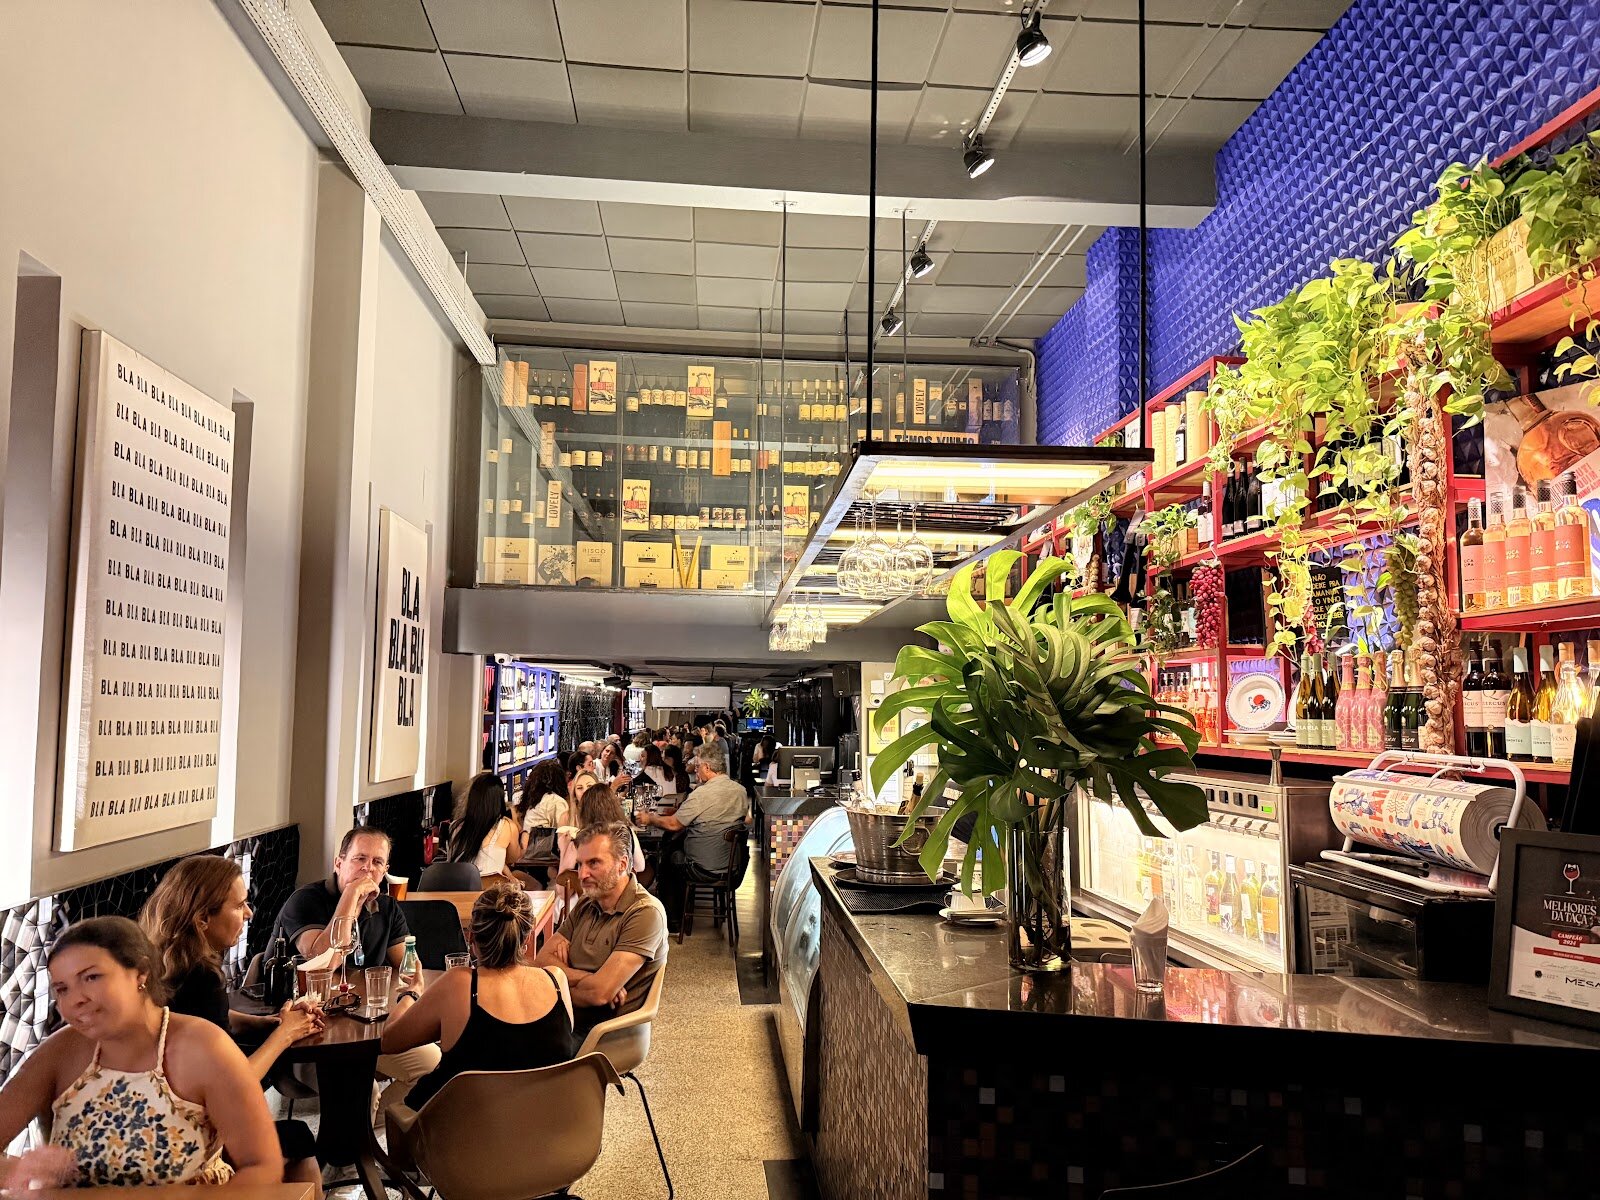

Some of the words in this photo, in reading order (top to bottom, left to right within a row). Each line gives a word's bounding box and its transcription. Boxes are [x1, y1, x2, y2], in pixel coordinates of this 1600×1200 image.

[118, 363, 133, 386] BLA
[137, 376, 147, 394] BLA
[152, 385, 165, 405] BLA
[169, 395, 178, 413] BLA
[182, 403, 191, 420] BLA
[194, 410, 205, 428] BLA
[208, 418, 217, 434] BLA
[220, 425, 230, 443] BLA
[916, 389, 925, 415] LOVELY
[117, 402, 128, 422] BLA
[133, 411, 147, 432] BLA
[151, 421, 160, 439] BLA
[165, 429, 177, 448] BLA
[181, 438, 193, 456] BLA
[196, 446, 204, 461] BLA
[208, 451, 218, 468] BLA
[114, 441, 131, 462] BLA
[135, 451, 145, 470] BLA
[149, 458, 162, 477] BLA
[166, 466, 176, 483] BLA
[179, 472, 189, 488] BLA
[192, 478, 203, 495] BLA
[206, 484, 214, 499] BLA
[217, 489, 227, 506] BLA
[112, 481, 125, 499] BLA
[129, 487, 143, 507] BLA
[148, 495, 158, 512] BLA
[161, 501, 174, 518] BLA
[178, 507, 190, 524] BLA
[193, 513, 202, 528] BLA
[205, 518, 215, 533] BLA
[218, 523, 226, 538] BLA
[549, 491, 559, 519] LOVELY
[110, 520, 127, 539] BLA
[131, 527, 142, 544] BLA
[146, 532, 159, 550] BLA
[163, 538, 173, 553] BLA
[176, 542, 185, 558] BLA
[189, 546, 200, 562] BLA
[203, 551, 211, 565] BLA
[214, 555, 224, 570] BLA
[108, 559, 121, 577] BLA
[125, 564, 140, 582] BLA
[144, 570, 154, 586] BLA
[158, 573, 171, 589] BLA
[175, 577, 187, 593] BLA
[190, 581, 199, 596] BLA
[202, 585, 213, 599] BLA
[401, 567, 419, 622] BLA
[1312, 574, 1326, 582] NÃO
[106, 599, 122, 617] BLA
[127, 604, 138, 620] BLA
[142, 607, 156, 623] BLA
[160, 611, 169, 625] BLA
[173, 613, 182, 628] BLA
[185, 615, 197, 630] BLA
[201, 618, 209, 632] BLA
[212, 620, 221, 634] BLA
[103, 639, 116, 656] BLA
[121, 642, 136, 658] BLA
[140, 645, 150, 660] BLA
[154, 647, 167, 662] BLA
[171, 649, 183, 663] BLA
[187, 650, 195, 664] BLA
[199, 652, 209, 666] BLA
[388, 618, 407, 673] BLA
[410, 626, 424, 674] BLA
[101, 679, 118, 695] BLA
[123, 682, 134, 697] BLA
[138, 683, 152, 698] BLA
[156, 684, 166, 698] BLA
[170, 685, 179, 698] BLA
[182, 685, 194, 699] BLA
[198, 686, 206, 699] BLA
[209, 687, 219, 700] BLA
[397, 676, 414, 726] BLA
[98, 720, 111, 735] BLA
[116, 721, 132, 736] BLA
[136, 721, 147, 735] BLA
[151, 721, 164, 735] BLA
[168, 721, 181, 734] BLA
[184, 720, 193, 733] BLA
[196, 720, 207, 733] BLA
[210, 720, 218, 733] BLA
[95, 761, 114, 777] BLA
[118, 760, 130, 775] BLA
[134, 759, 149, 774] BLA
[153, 757, 163, 772] BLA
[167, 757, 176, 771] BLA
[179, 755, 190, 769] BLA
[194, 754, 203, 768] BLA
[206, 754, 216, 766] BLA
[90, 801, 105, 819] BLA
[108, 800, 125, 815] BLA
[129, 797, 142, 813] BLA
[144, 794, 160, 810] BLA
[162, 792, 175, 807] BLA
[178, 790, 188, 804] BLA
[192, 788, 204, 802] BLA
[206, 786, 216, 801] BLA
[1543, 900, 1597, 915] MELHORES
[1551, 911, 1564, 921] DA
[1565, 912, 1588, 926] TAÇA
[1558, 933, 1583, 941] CAMPEÃO
